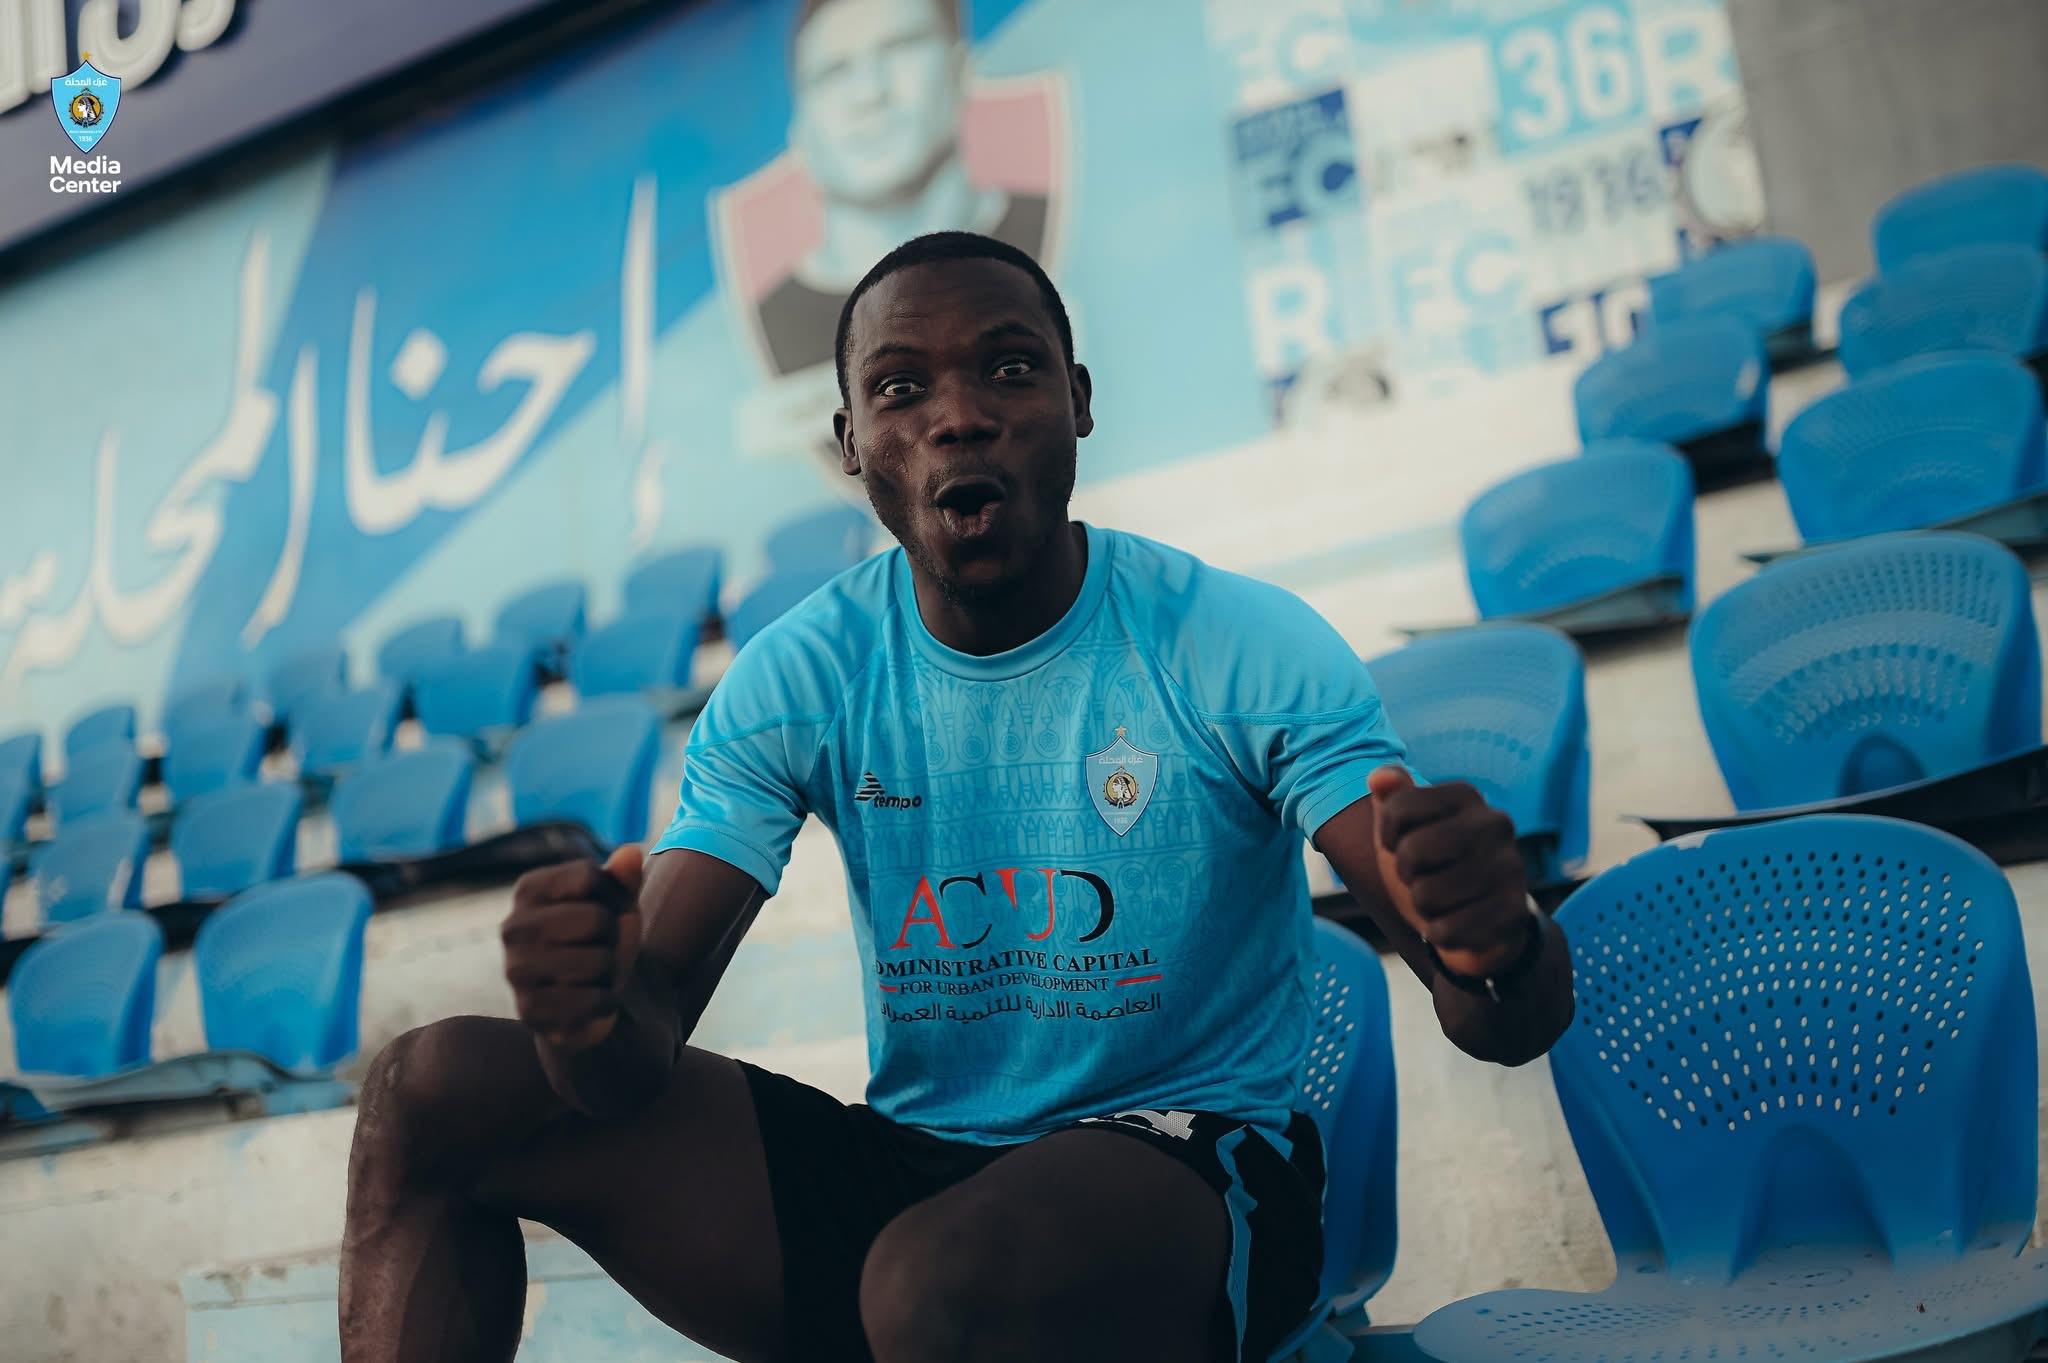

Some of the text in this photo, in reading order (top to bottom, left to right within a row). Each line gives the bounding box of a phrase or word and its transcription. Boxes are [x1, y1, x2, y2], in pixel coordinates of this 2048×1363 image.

[1502, 9, 1631, 141] 36
[873, 794, 922, 811] tempo
[888, 867, 1115, 950] ACUD
[876, 947, 1158, 977] DMINISTRATIVE CAPITAL
[900, 972, 1110, 996] FOR URBAN DEVELOPMENT
[946, 993, 1022, 1024] للتنمية
[1075, 992, 1161, 1020] العاصمة
